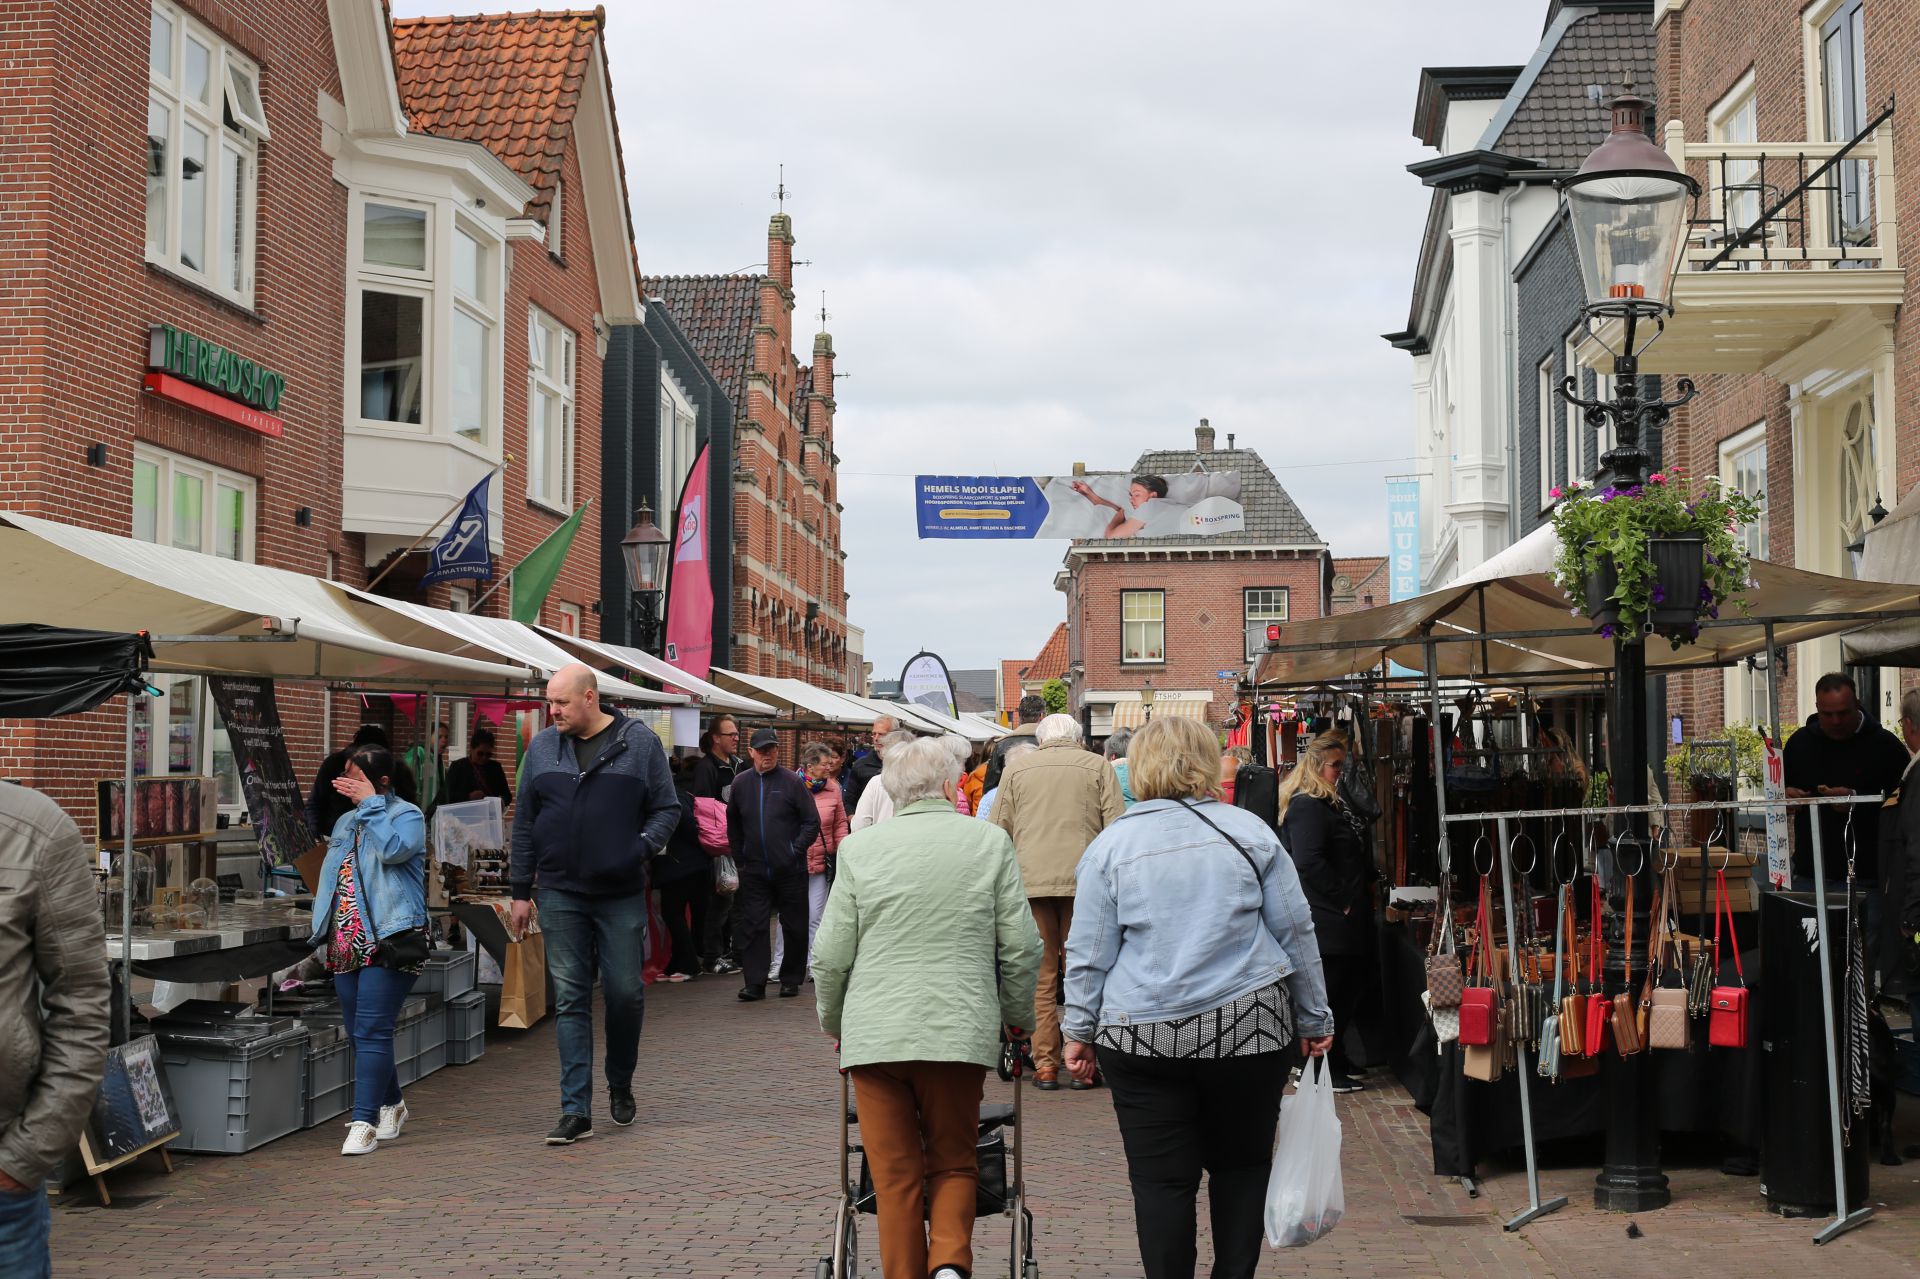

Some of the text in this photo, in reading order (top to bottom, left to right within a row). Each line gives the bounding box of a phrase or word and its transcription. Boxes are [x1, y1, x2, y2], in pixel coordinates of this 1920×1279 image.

[923, 485, 1025, 494] HEMELS MOOI SLAPEN
[1205, 513, 1240, 523] BOXSPRING
[1392, 511, 1416, 601] MUSE
[1767, 756, 1782, 788] TOP
